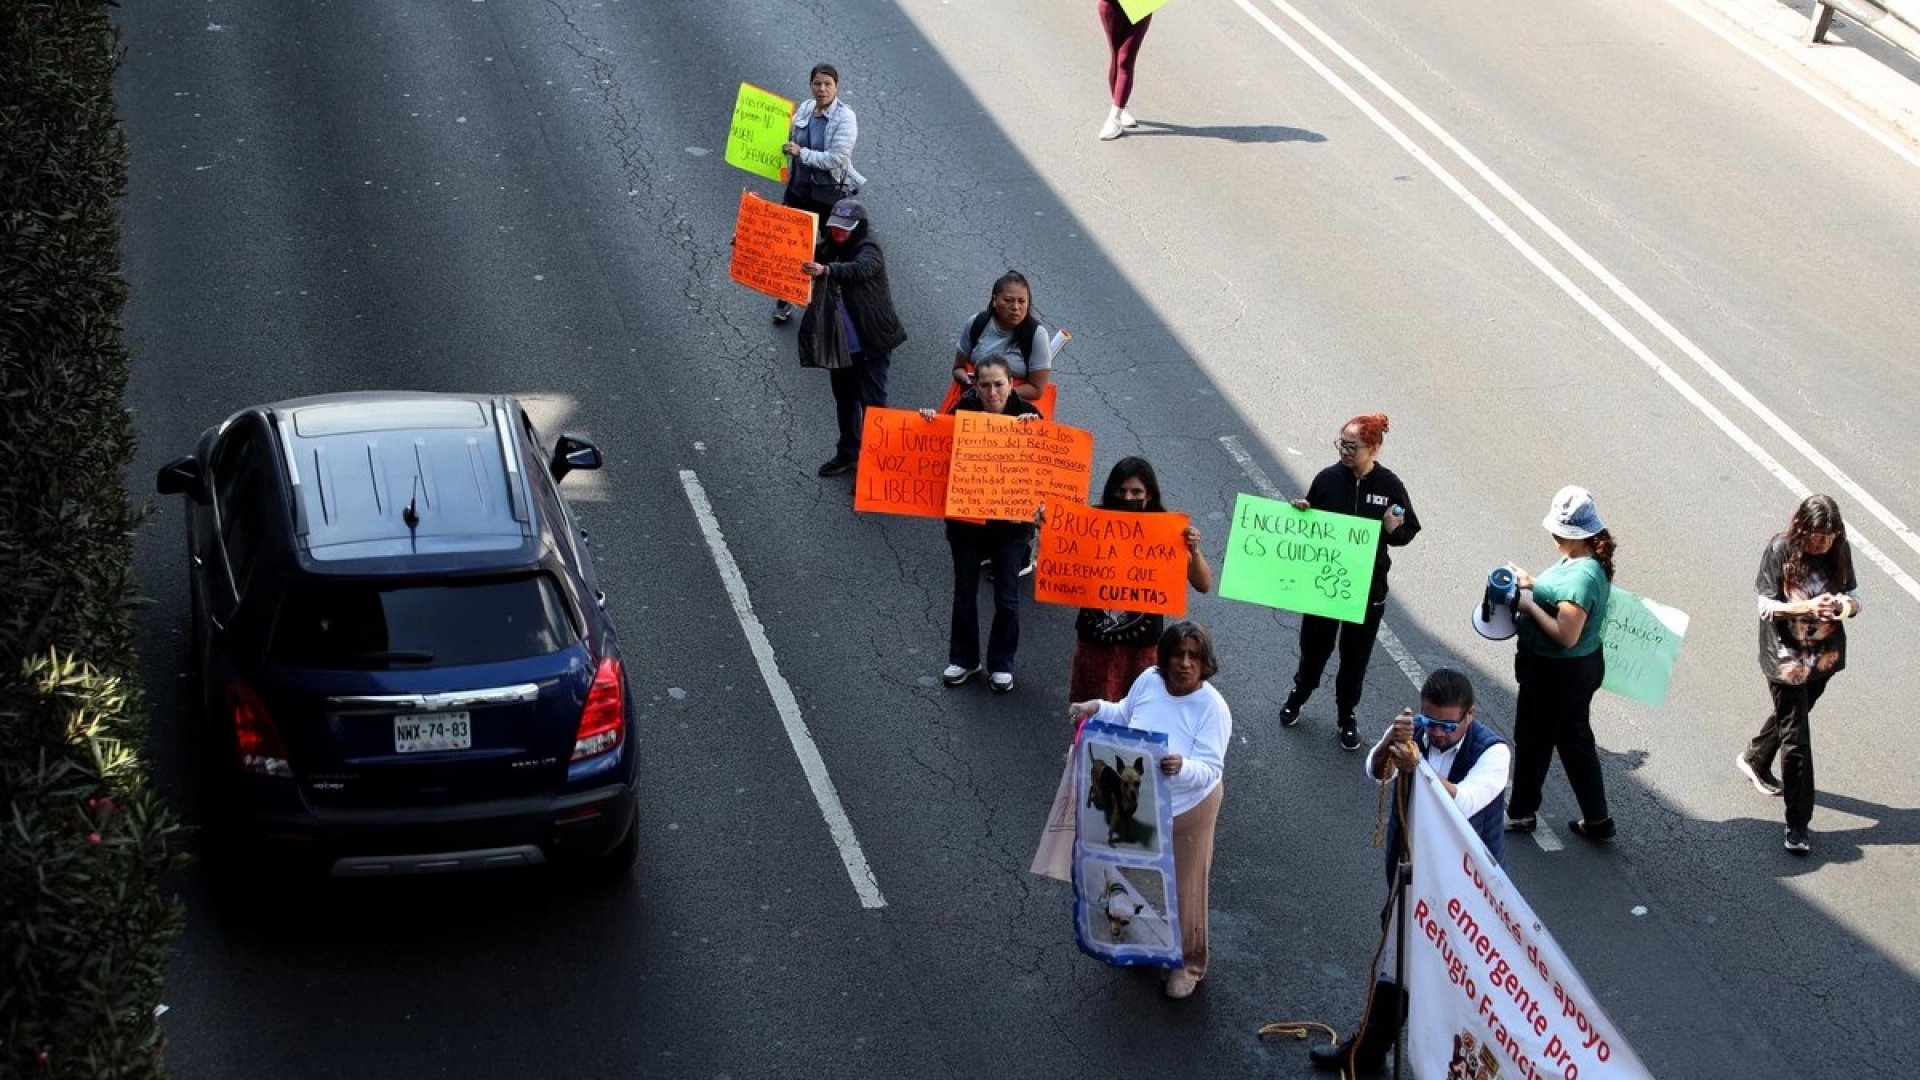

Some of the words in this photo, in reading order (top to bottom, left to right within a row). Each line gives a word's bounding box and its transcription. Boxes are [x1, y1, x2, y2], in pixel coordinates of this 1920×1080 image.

[867, 416, 889, 453] Si
[961, 418, 977, 433] El
[1050, 503, 1145, 540] BRUGADA
[1240, 503, 1337, 540] ENCERRAR
[1348, 527, 1370, 545] NO
[1055, 535, 1079, 555] DA
[1095, 543, 1118, 560] LA
[1133, 543, 1177, 561] CARA
[1276, 540, 1342, 567] CUIDAR
[1040, 558, 1116, 580] QUEREMOS
[1127, 566, 1157, 582] QUE
[1039, 579, 1086, 595] RINDAS
[1099, 584, 1168, 605] CUENTAS
[1463, 851, 1522, 946] Comité
[1526, 944, 1549, 982] de
[1552, 980, 1611, 1063] apoyo
[1414, 898, 1477, 1000] Refugio
[1478, 994, 1544, 1080] Franci
[1447, 898, 1548, 1038] emergente
[1543, 1034, 1579, 1080] pro
